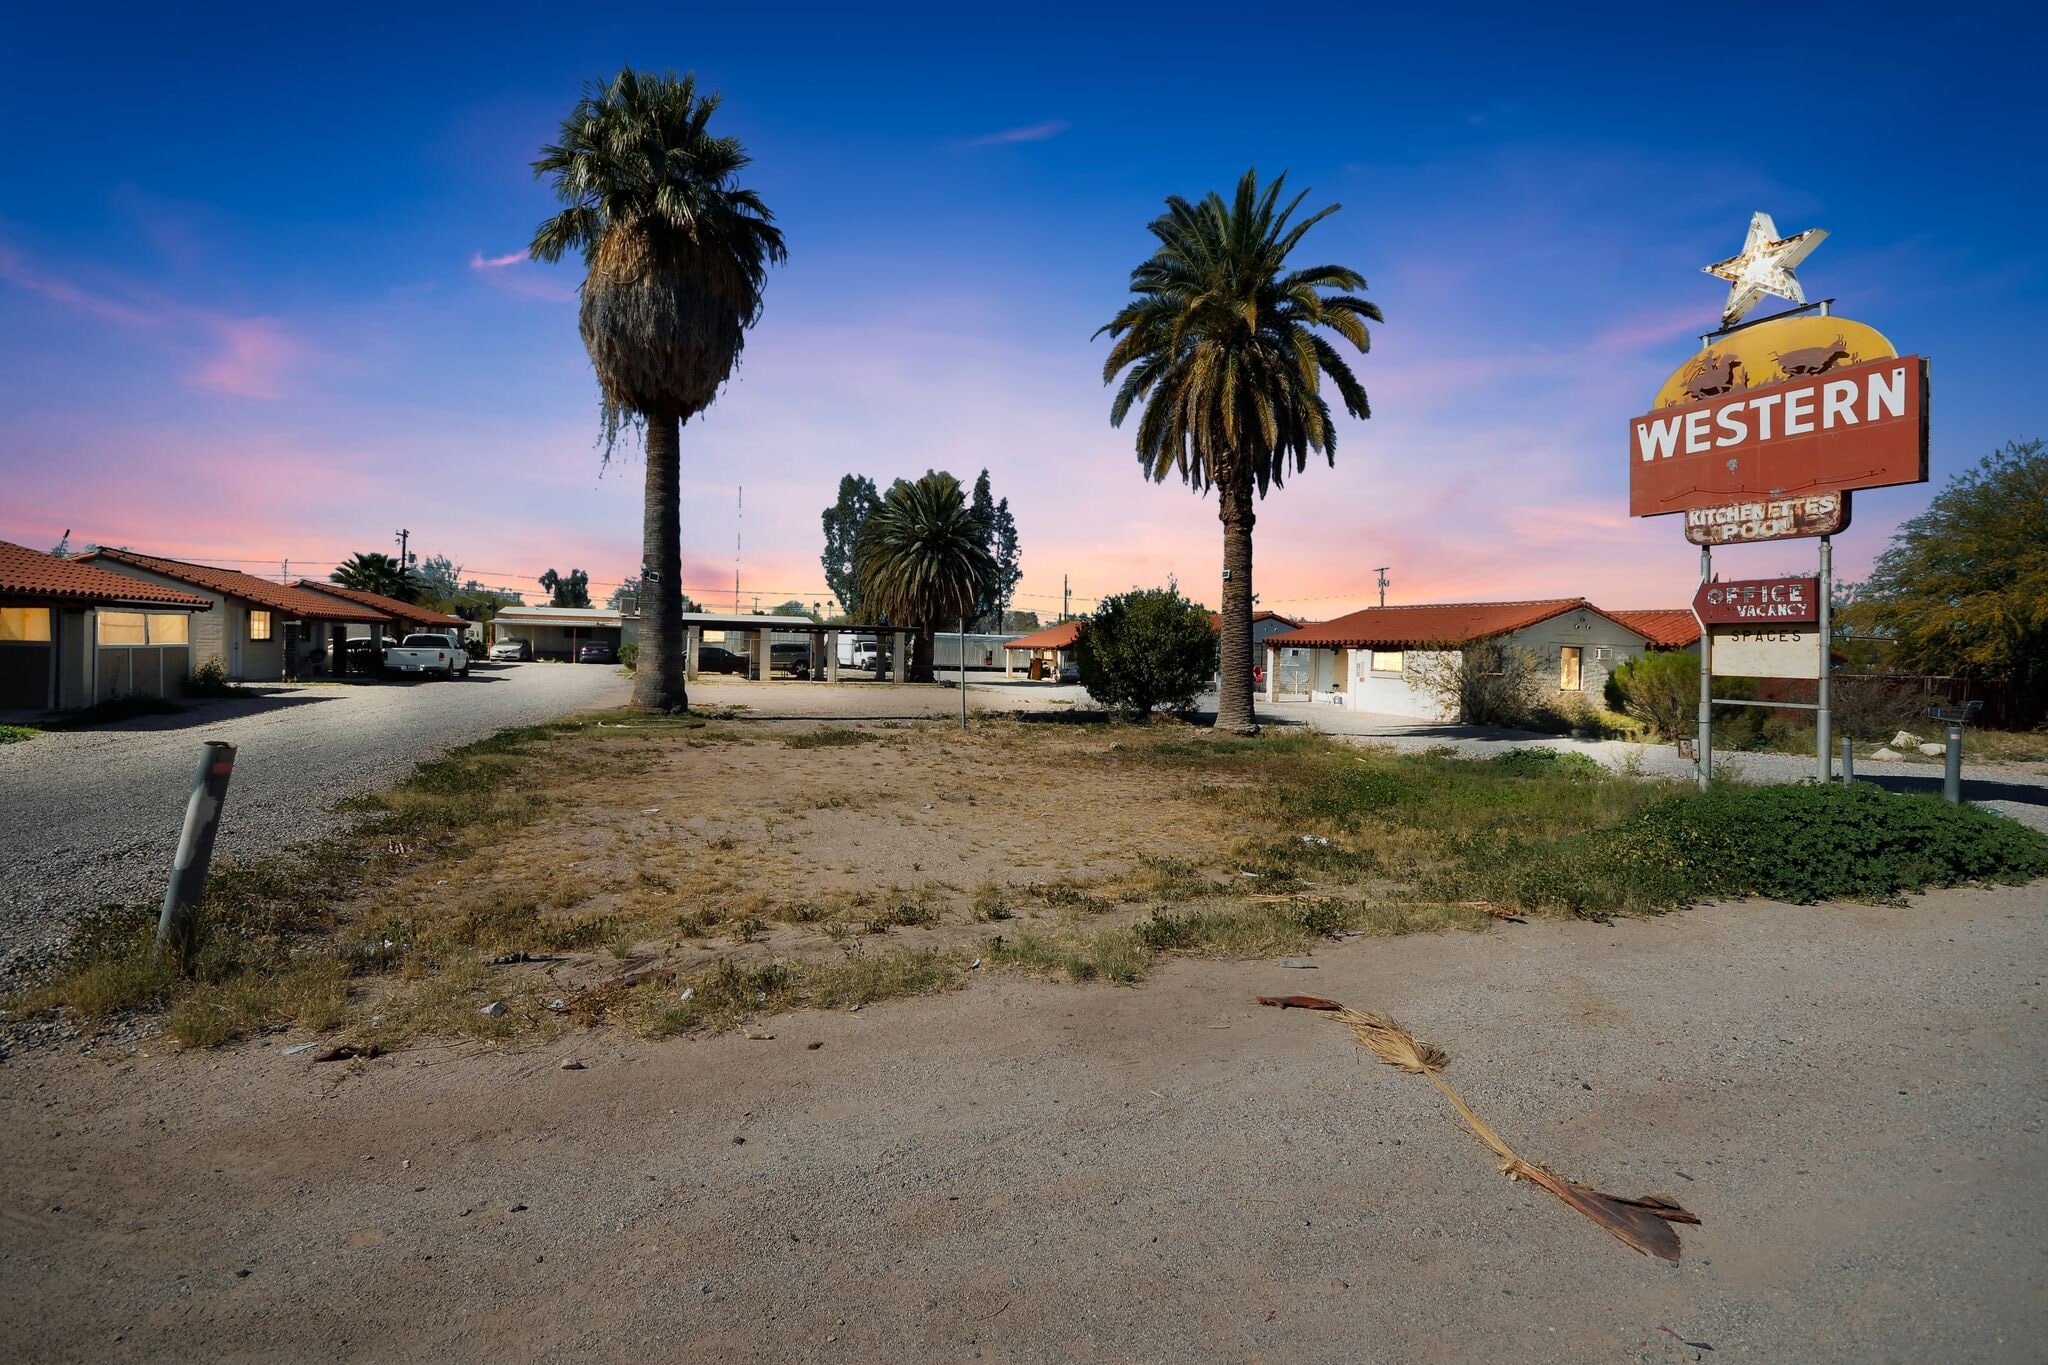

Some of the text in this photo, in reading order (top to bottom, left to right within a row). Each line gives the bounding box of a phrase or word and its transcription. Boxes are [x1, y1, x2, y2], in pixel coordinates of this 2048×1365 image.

[1637, 367, 1905, 461] WESTERN
[1689, 495, 1835, 526] KITCHENETTES
[1722, 516, 1798, 540] POOL
[1708, 584, 1804, 604] OFFICE
[1737, 603, 1808, 617] VACANCY
[1732, 630, 1801, 642] SPACES
